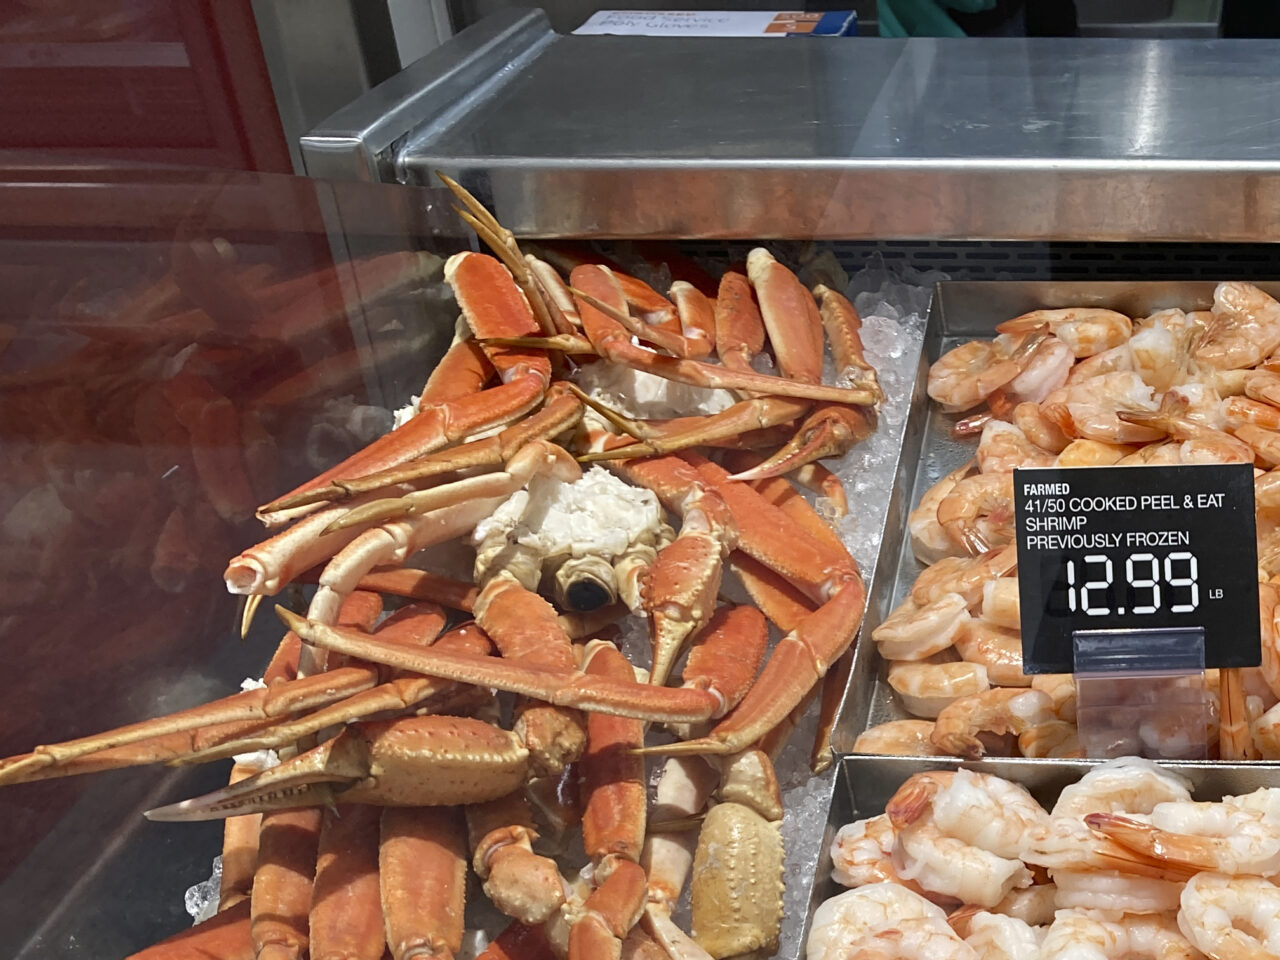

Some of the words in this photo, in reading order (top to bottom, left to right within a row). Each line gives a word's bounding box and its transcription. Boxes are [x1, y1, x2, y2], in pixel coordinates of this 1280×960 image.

[1024, 483, 1070, 496] FARMED
[1025, 499, 1065, 512] 41/50
[1069, 497, 1137, 511] COOKED
[1141, 495, 1179, 509] PEEL
[1183, 495, 1194, 508] &
[1198, 494, 1225, 507] EAT
[1026, 516, 1087, 531] SHRIMP
[1027, 534, 1122, 550] PREVIOUSLY
[1127, 532, 1189, 547] FROZEN
[1067, 552, 1199, 615] 12.99
[1209, 589, 1224, 599] LB
